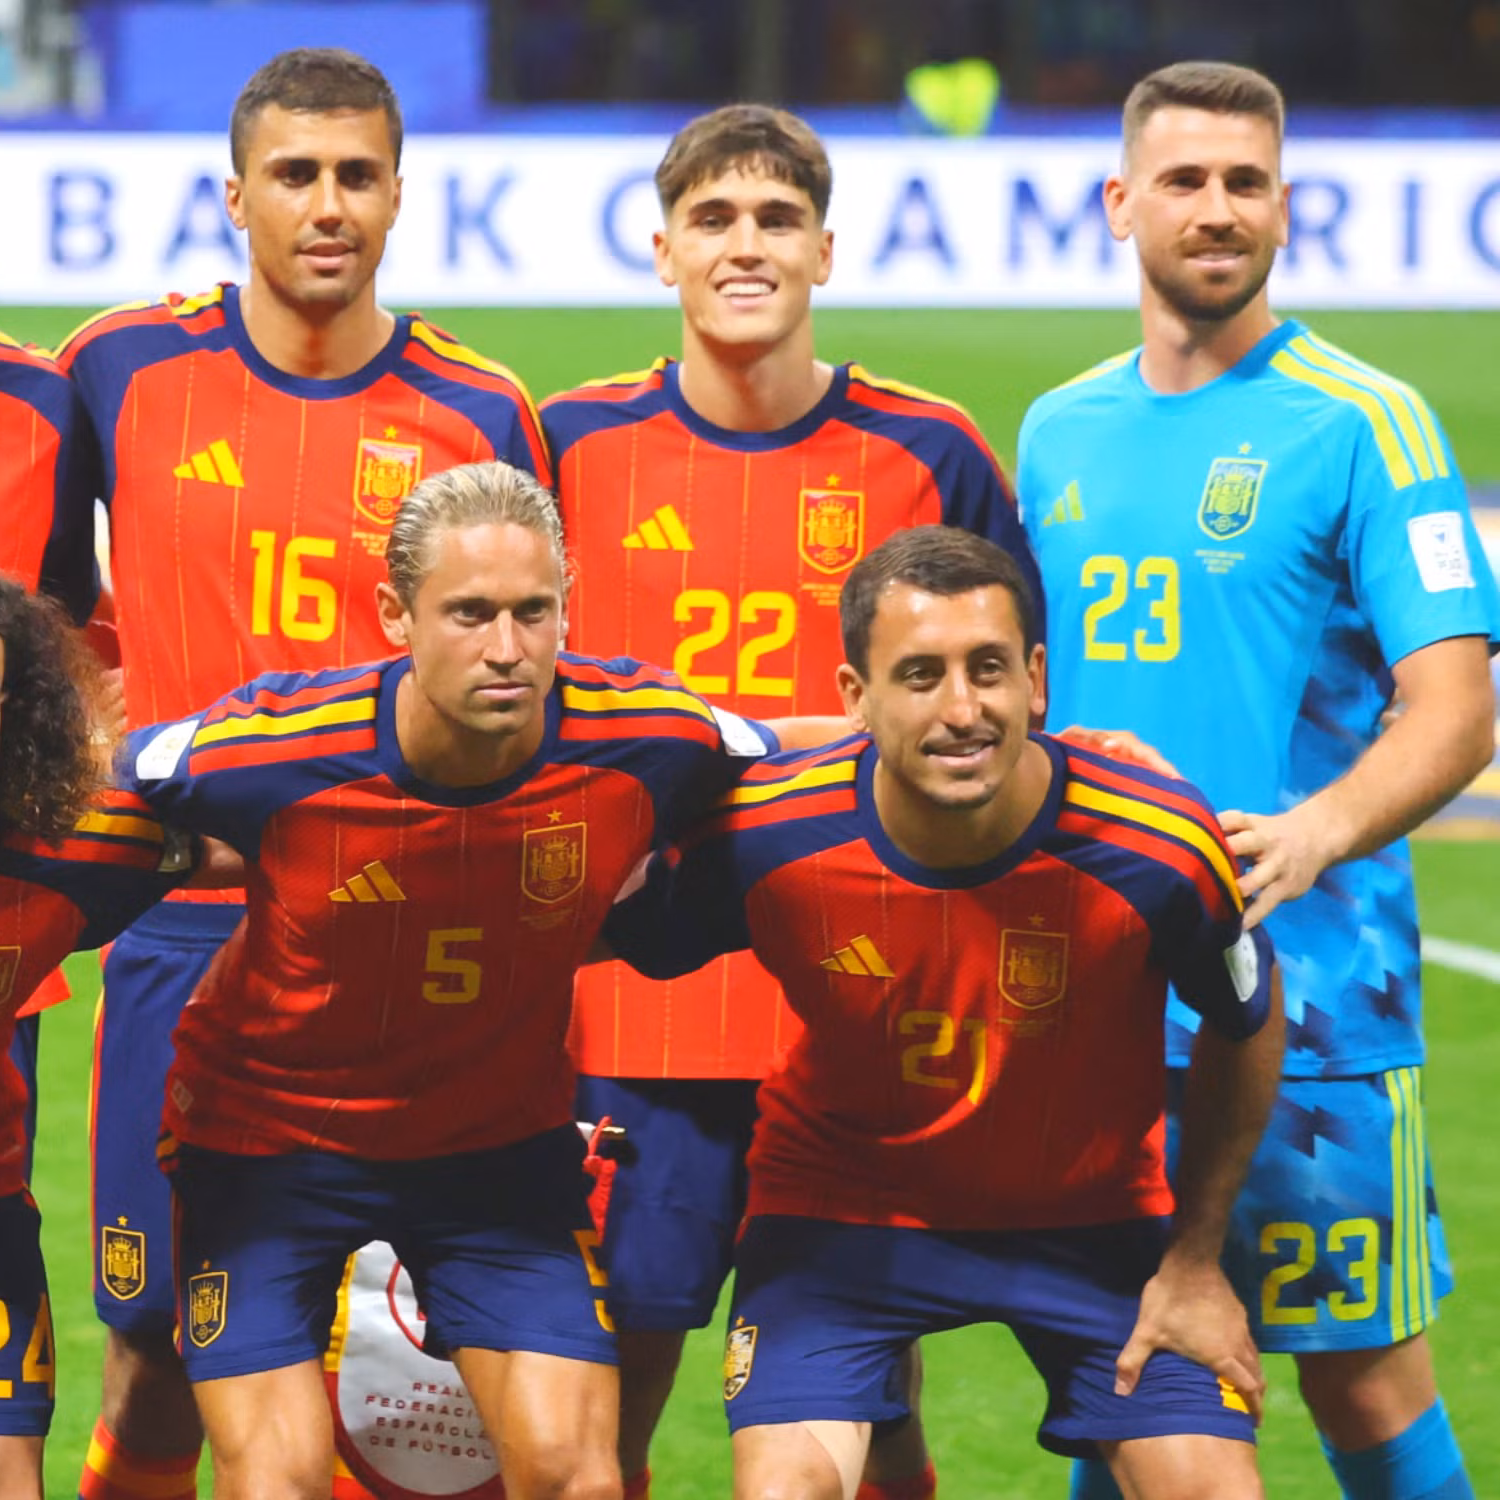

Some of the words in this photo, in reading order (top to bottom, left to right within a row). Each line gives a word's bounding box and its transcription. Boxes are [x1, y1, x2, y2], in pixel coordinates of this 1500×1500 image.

[49, 168, 514, 269] BAK
[871, 172, 1500, 270] AMRI
[251, 530, 337, 642] 16
[1080, 555, 1181, 662] 23
[673, 589, 797, 696] 22
[422, 927, 483, 1004] 5
[899, 1010, 986, 1105] 21
[1259, 1217, 1381, 1326] 23
[365, 1394, 473, 1418] FEDERACI
[412, 1382, 463, 1398] REAL
